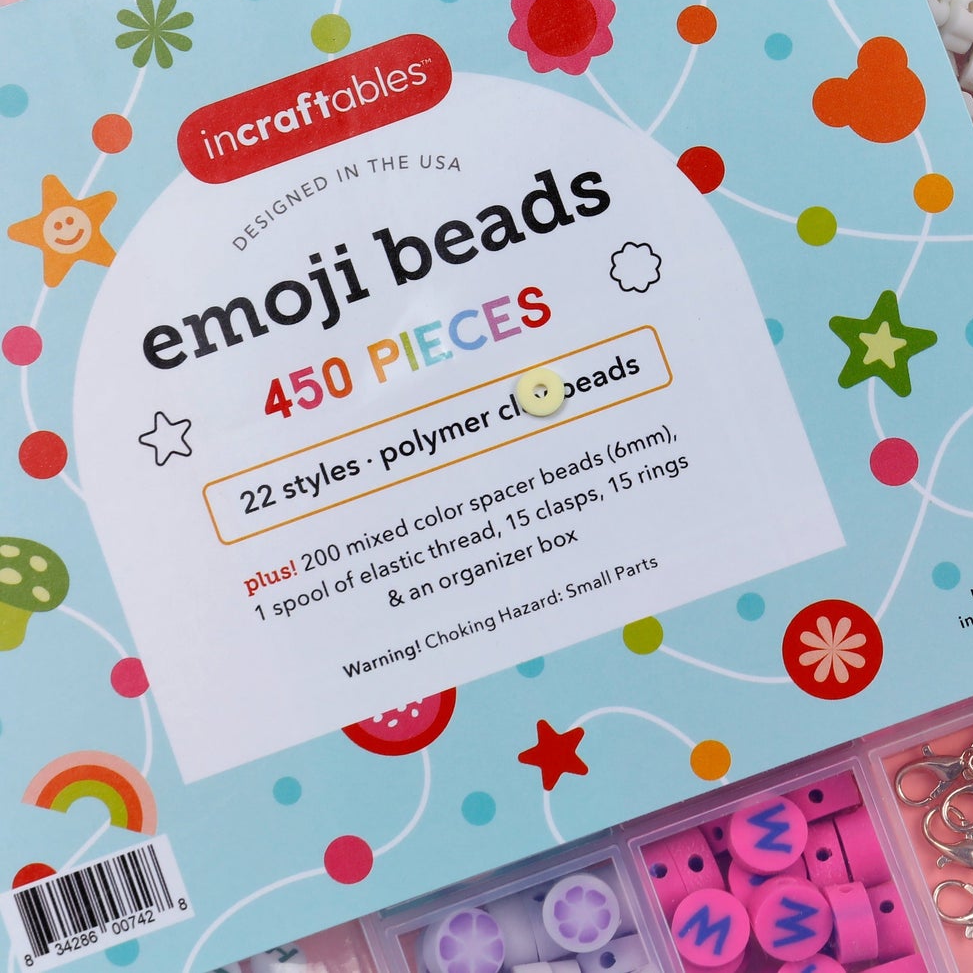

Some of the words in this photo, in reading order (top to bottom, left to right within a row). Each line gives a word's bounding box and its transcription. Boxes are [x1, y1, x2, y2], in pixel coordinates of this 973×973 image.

[232, 176, 328, 252] DESIGNED
[336, 164, 359, 182] IN
[367, 155, 409, 173] THE
[420, 154, 461, 172] USA
[142, 242, 371, 370] emoji
[371, 168, 611, 287] beads
[264, 356, 353, 419] 450
[367, 286, 552, 383] PIECES
[239, 484, 277, 515] 22
[282, 459, 361, 500] styles
[379, 410, 490, 472] polymer
[244, 559, 298, 597] plus!
[300, 543, 341, 572] 200
[346, 517, 409, 556] mixed
[413, 502, 464, 531] color
[469, 476, 535, 513] spacer
[538, 451, 604, 486] beads
[606, 424, 677, 464] (6mm),
[254, 604, 266, 621] 1
[272, 580, 330, 618] spool
[334, 570, 354, 593] of
[360, 550, 426, 584] elastic
[427, 519, 502, 559] thread,
[505, 508, 531, 530] 15
[535, 489, 604, 520] clasps,
[607, 471, 633, 493] 15
[637, 456, 689, 484] rings
[388, 589, 406, 608] &
[408, 582, 434, 601] an
[438, 545, 533, 589] organizer
[536, 529, 579, 554] box
[342, 639, 422, 678] Warning!
[424, 616, 497, 649] Choking
[497, 589, 564, 623] Hazard:
[565, 569, 612, 599] Small
[614, 557, 658, 581] Parts
[24, 954, 35, 967] 8
[55, 931, 98, 956] 34286
[112, 910, 156, 935] 00742
[177, 898, 188, 911] 8
